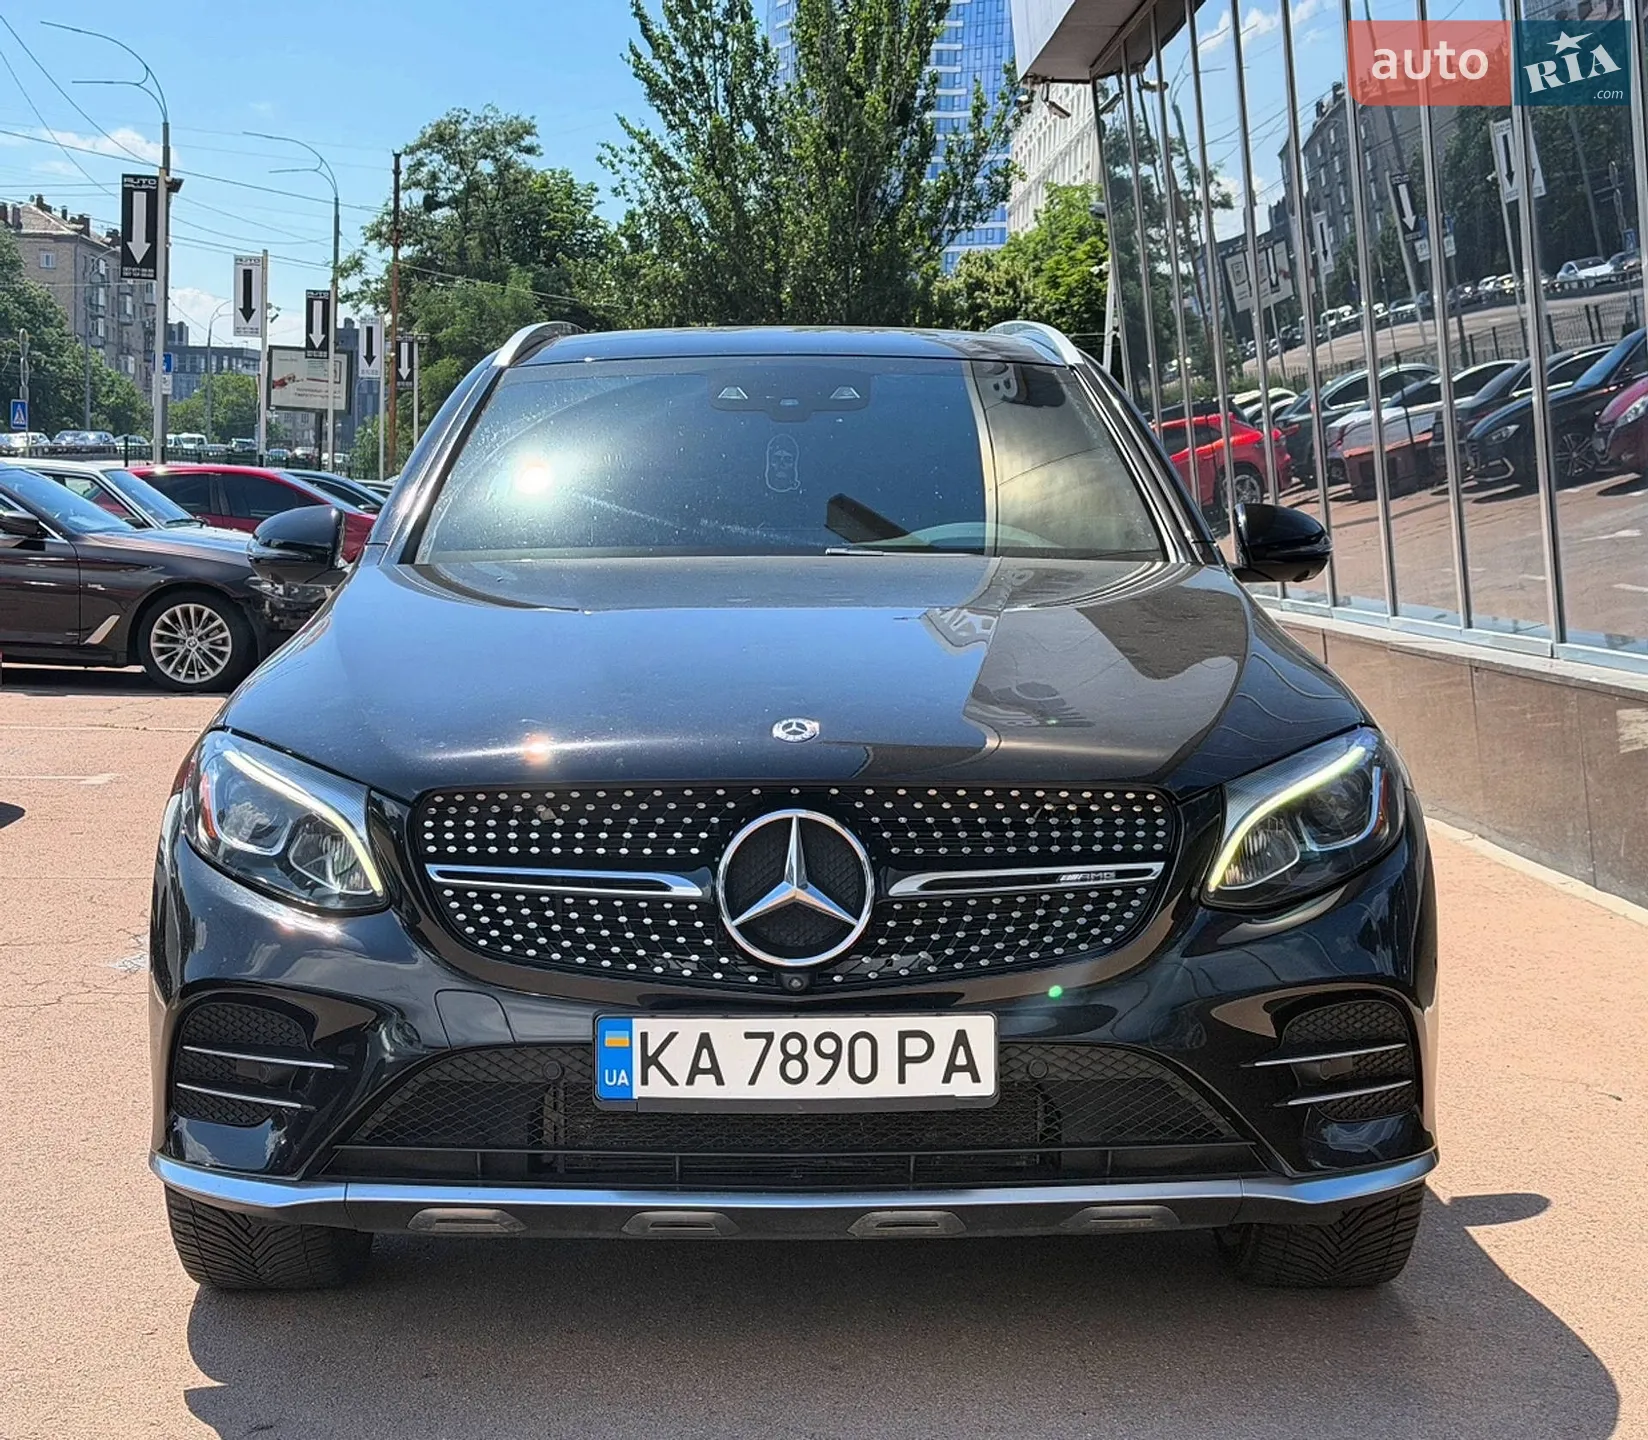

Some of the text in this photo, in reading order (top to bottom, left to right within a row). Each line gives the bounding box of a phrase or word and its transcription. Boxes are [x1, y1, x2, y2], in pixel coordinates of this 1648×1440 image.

[639, 1029, 982, 1087] KA 7890 PA
[604, 1069, 630, 1087] UA
